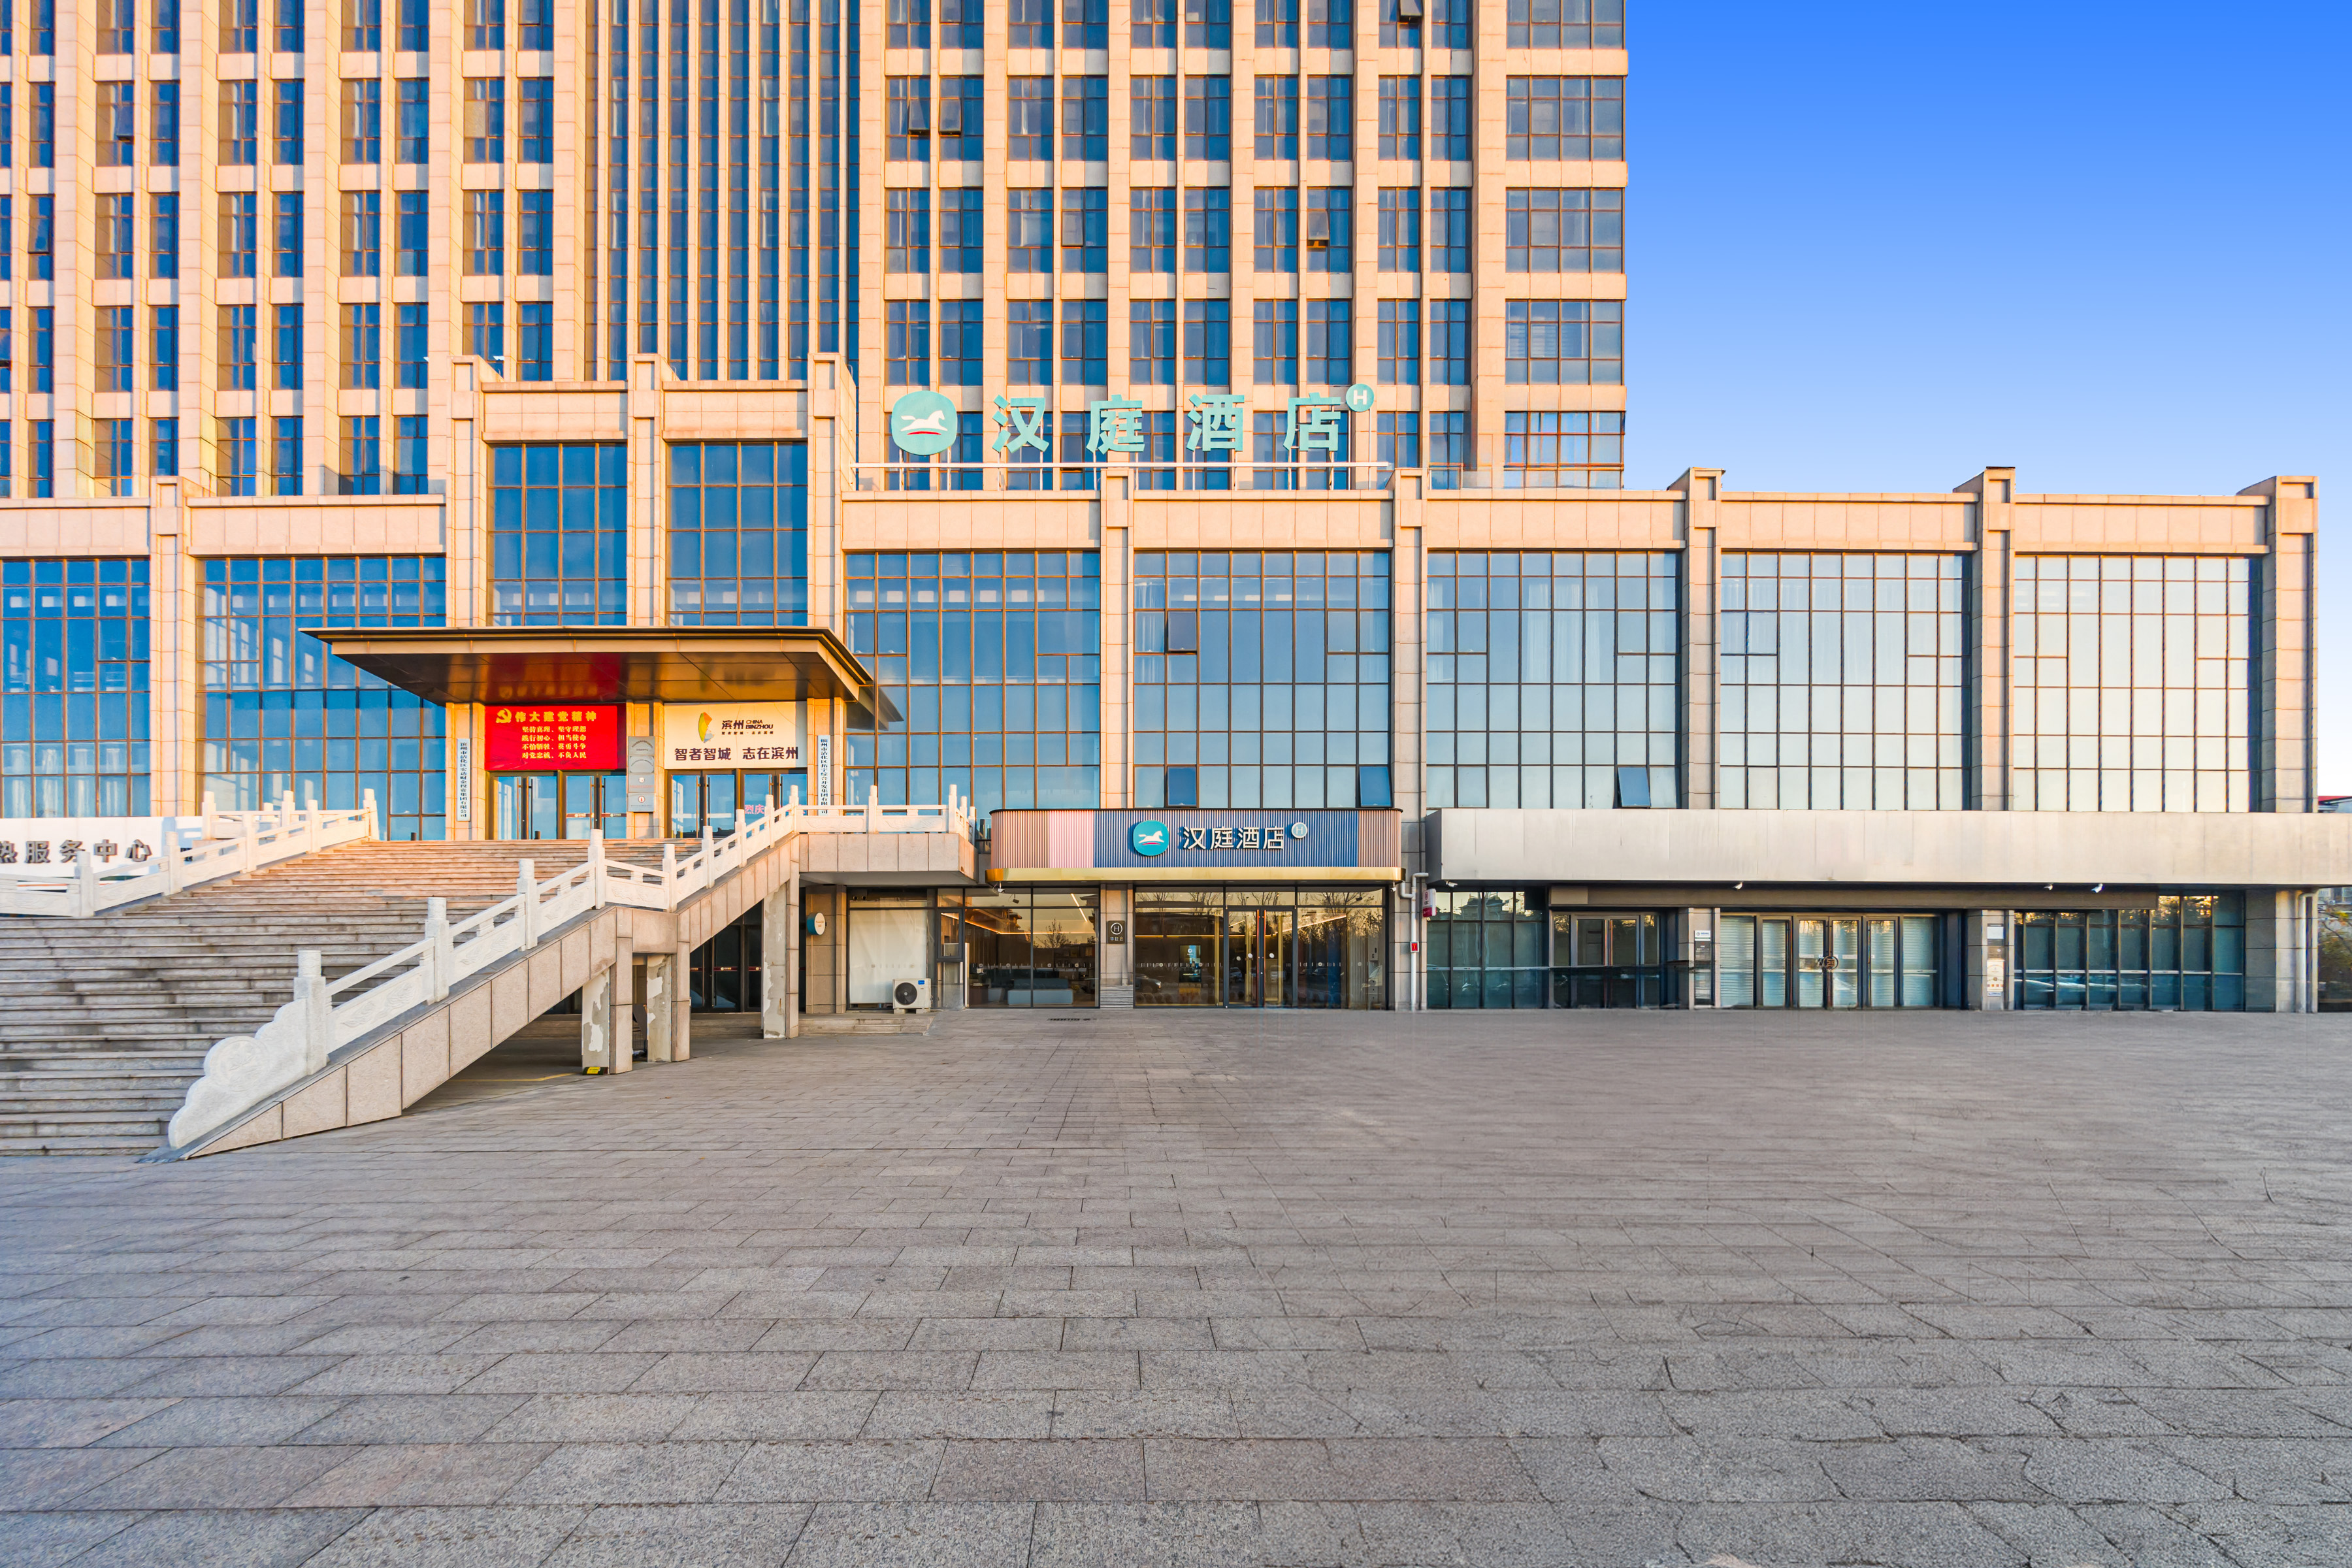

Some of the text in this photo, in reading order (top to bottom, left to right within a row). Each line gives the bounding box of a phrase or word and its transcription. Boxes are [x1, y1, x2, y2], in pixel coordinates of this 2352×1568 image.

[1353, 389, 1367, 405] H
[992, 393, 1341, 455] 汉庭酒店
[515, 711, 596, 723] 伟大建党精神
[721, 720, 744, 730] 滨州
[675, 747, 798, 761] 智者智城 志在滨州
[1183, 826, 1284, 849] 汉庭酒店
